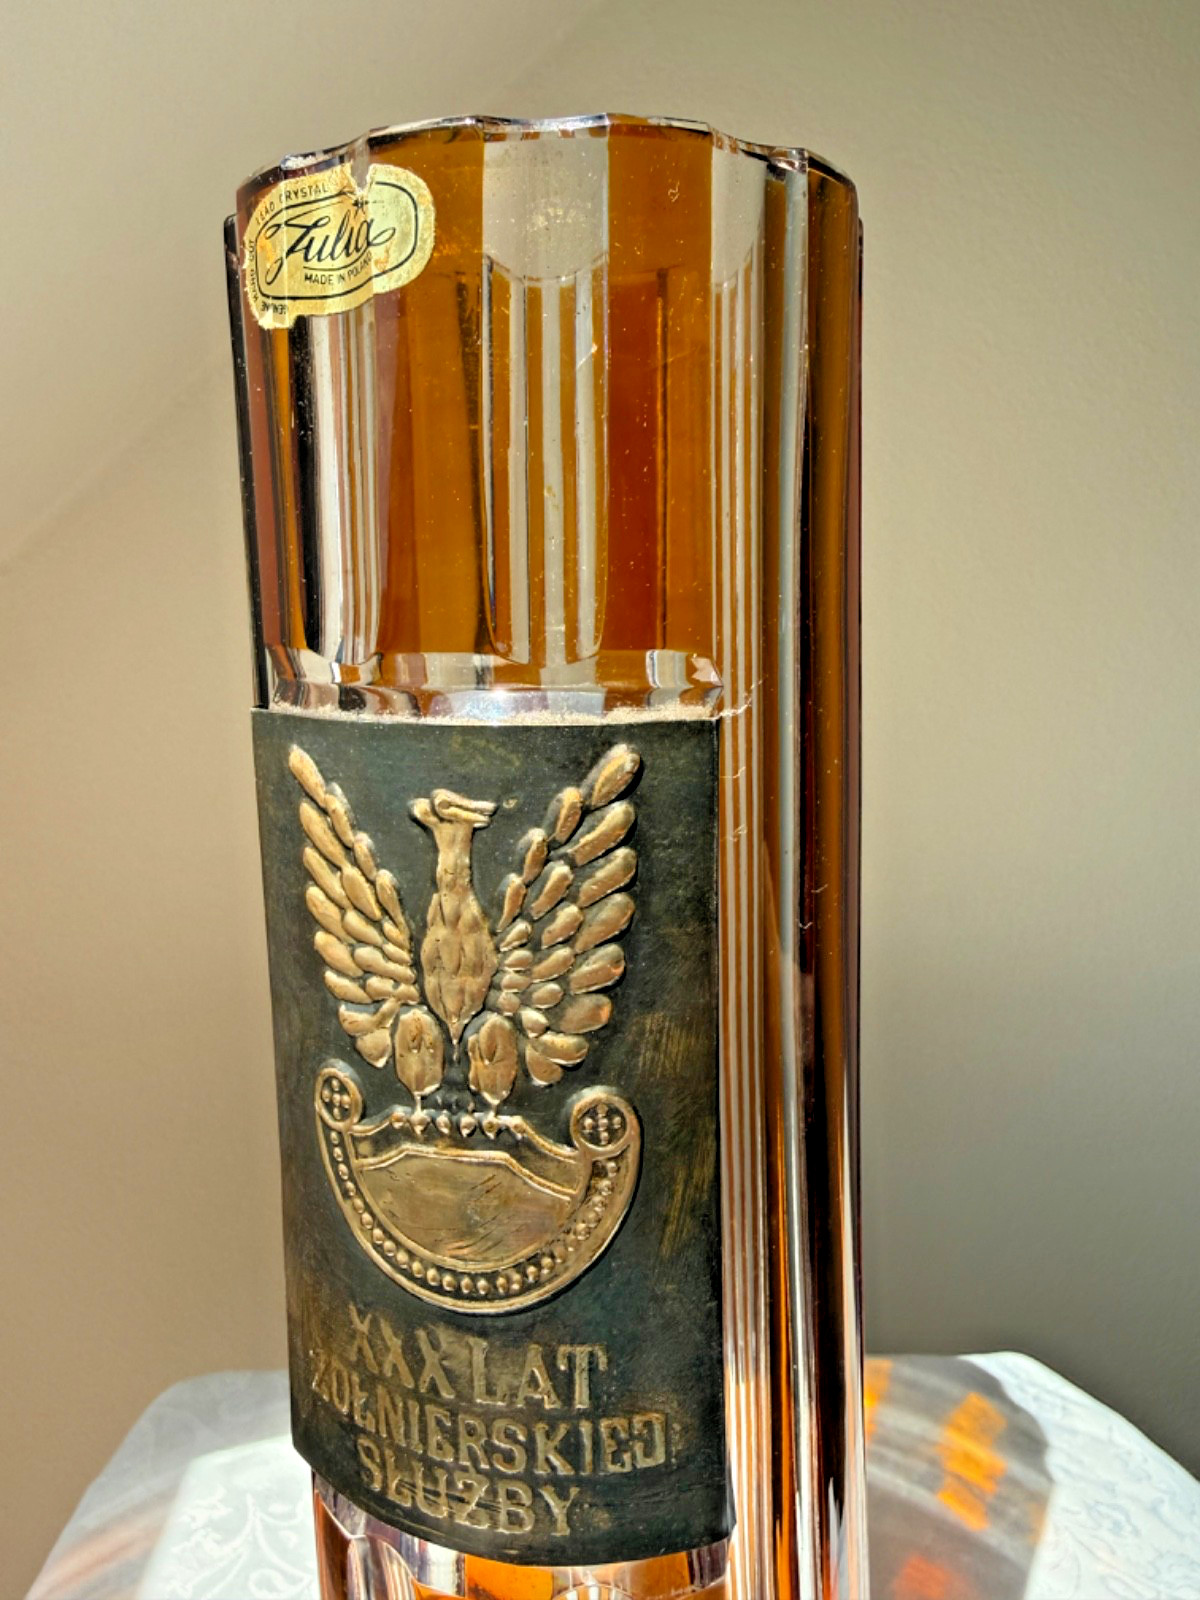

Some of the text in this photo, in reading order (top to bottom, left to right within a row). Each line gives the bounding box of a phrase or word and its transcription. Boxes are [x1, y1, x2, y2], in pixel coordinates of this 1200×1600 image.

[279, 182, 329, 204] CRYSTAL
[304, 272, 334, 285] MADE
[347, 250, 372, 281] POLAND
[348, 1303, 608, 1410] XXX LAT
